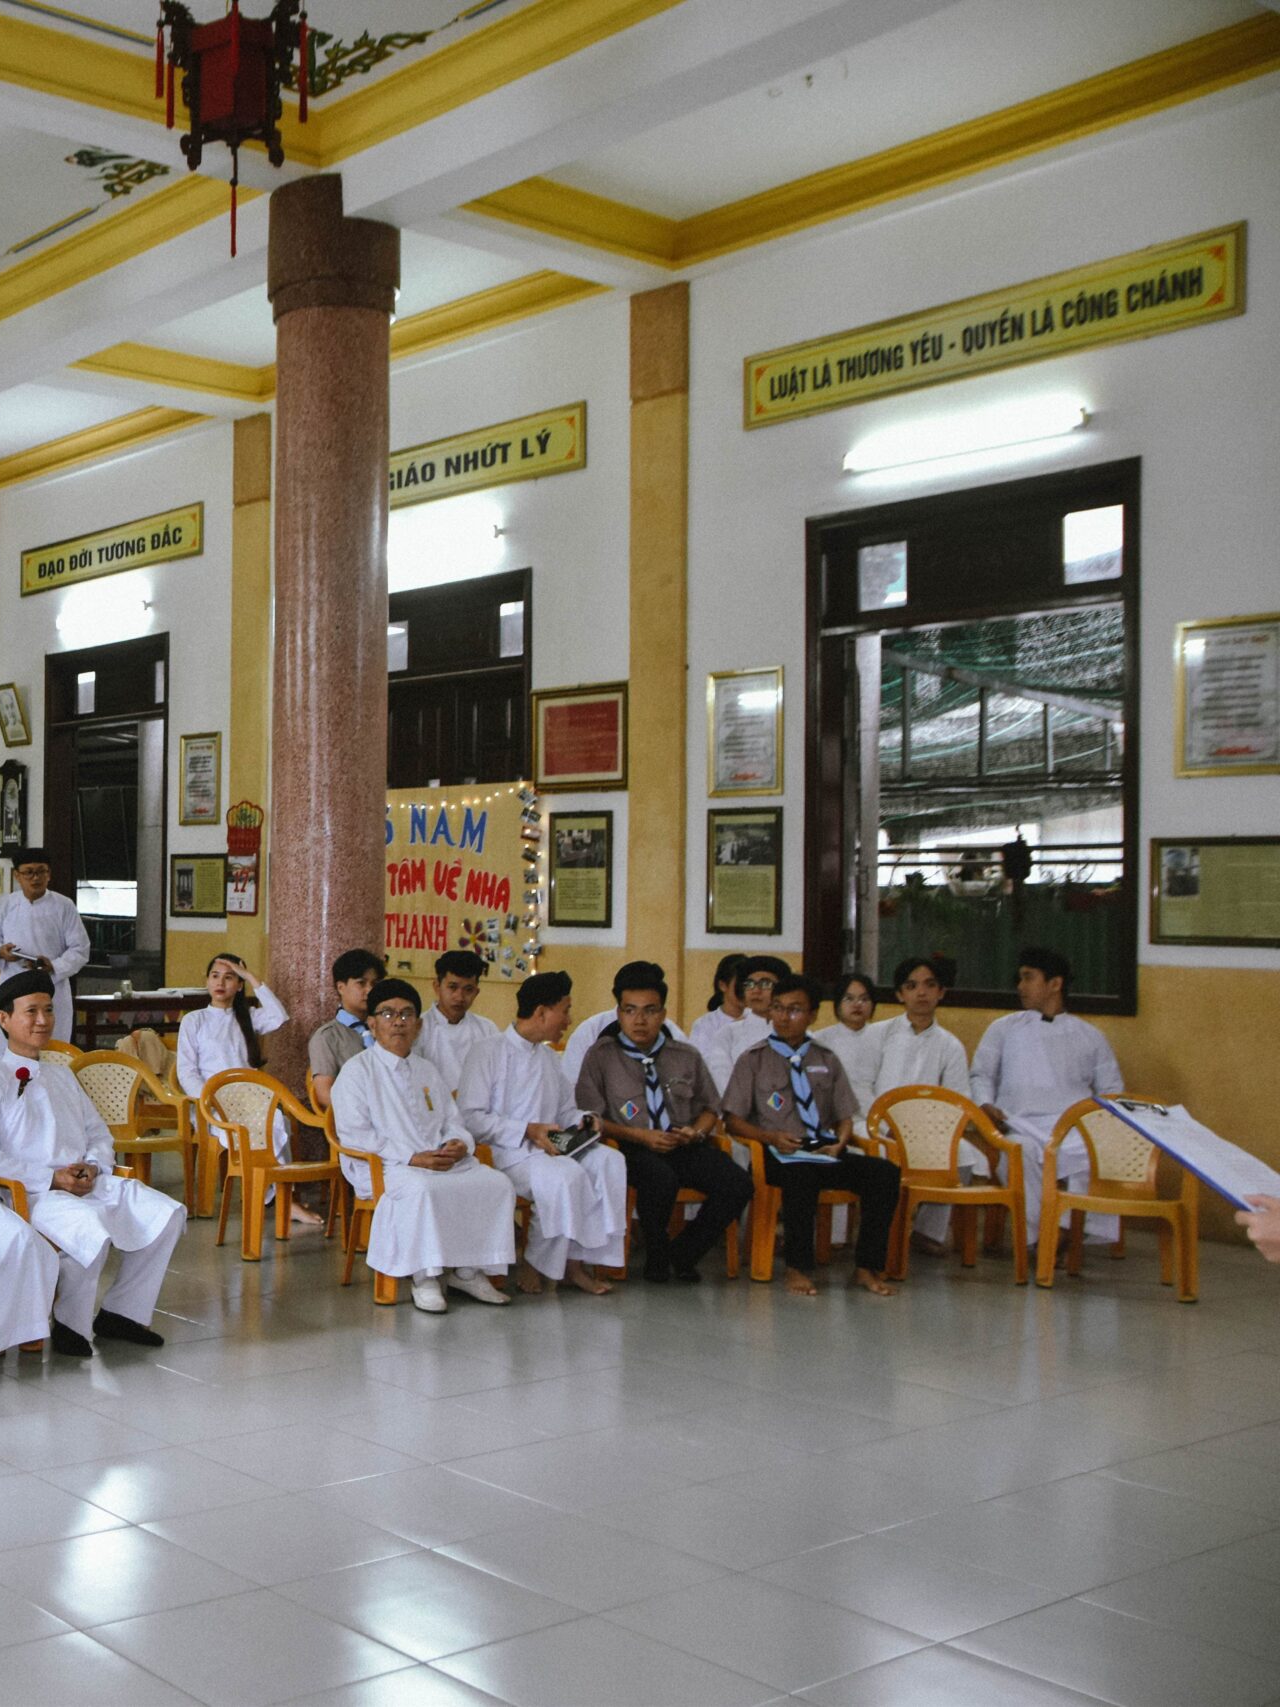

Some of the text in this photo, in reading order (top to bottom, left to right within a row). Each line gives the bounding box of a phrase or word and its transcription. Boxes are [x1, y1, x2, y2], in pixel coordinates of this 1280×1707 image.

[770, 367, 808, 401] LUẬT
[837, 344, 904, 384] THƯƠNG
[1127, 267, 1203, 312] CHÁNH
[445, 442, 511, 477] NHỨT
[521, 428, 551, 459] LÝ
[38, 558, 64, 579] ĐẠO
[97, 537, 146, 564] TƯƠNG
[151, 524, 182, 550] ĐẮC
[387, 857, 426, 896] TÂM
